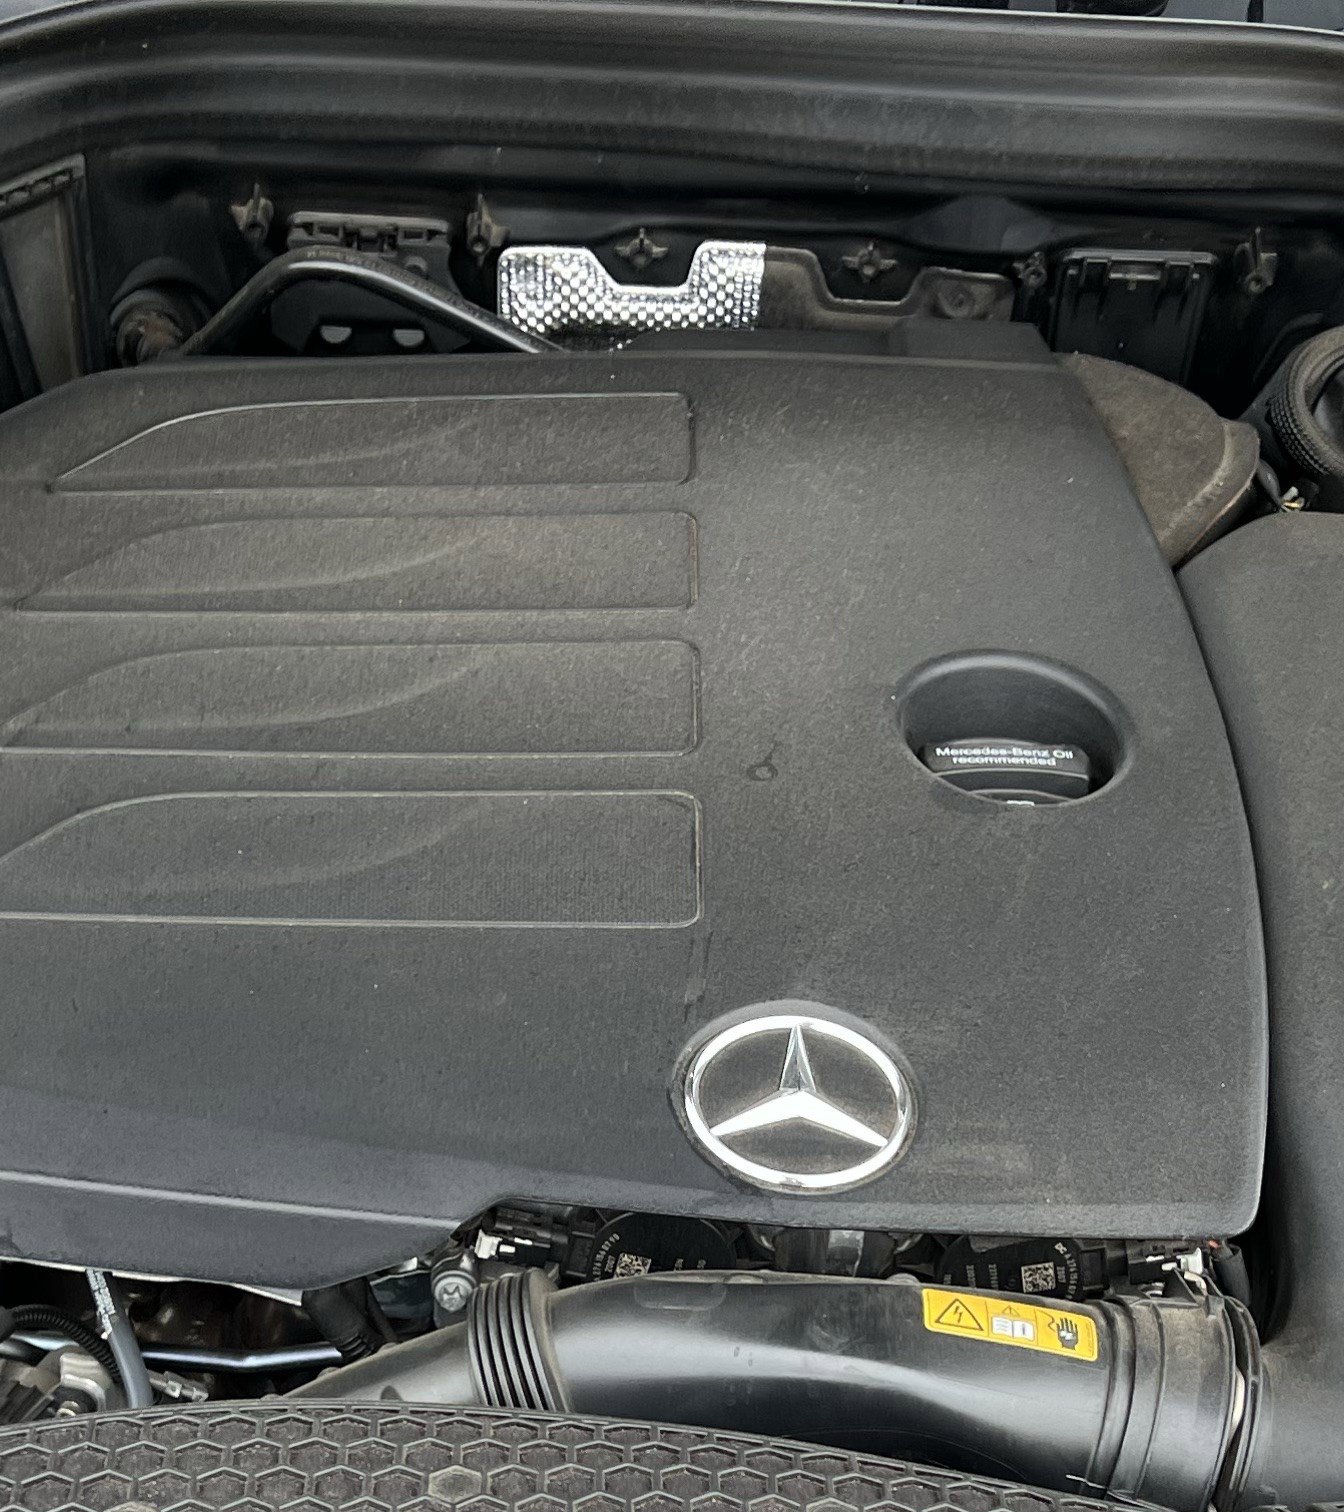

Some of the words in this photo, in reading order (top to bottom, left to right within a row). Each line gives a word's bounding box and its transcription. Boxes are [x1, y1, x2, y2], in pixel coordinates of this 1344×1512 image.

[935, 746, 1050, 757] Mercedes-Benz
[1052, 749, 1074, 760] Oil
[952, 756, 1057, 766] recommended
